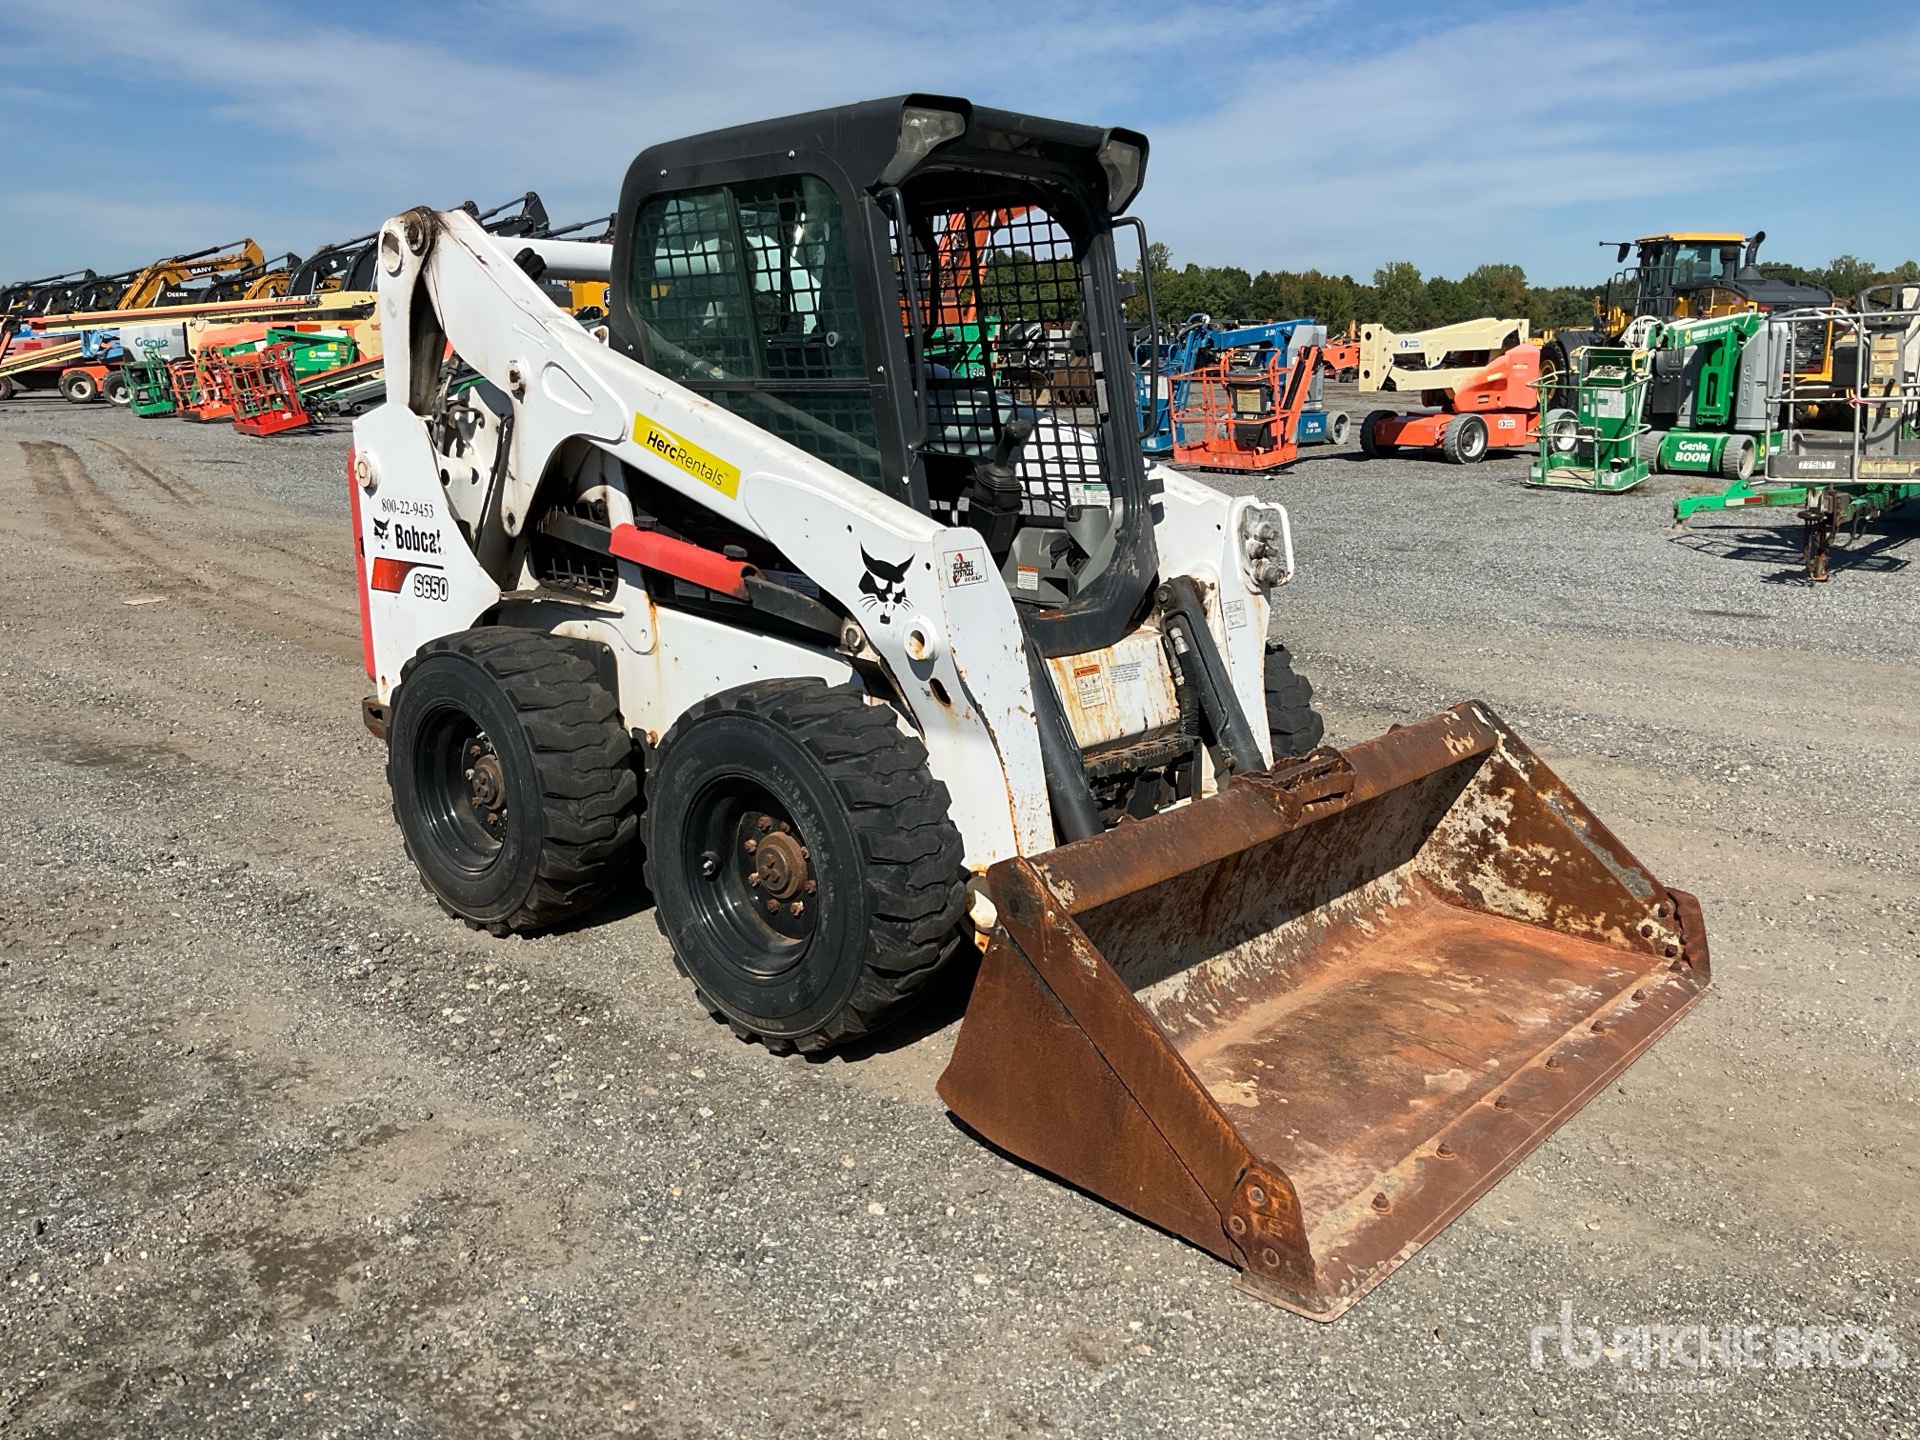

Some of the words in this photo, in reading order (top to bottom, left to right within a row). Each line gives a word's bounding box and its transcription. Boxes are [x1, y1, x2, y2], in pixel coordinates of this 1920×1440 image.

[191, 266, 212, 275] SANY
[1678, 441, 1709, 451] Genie
[1674, 452, 1711, 463] BOOM
[381, 498, 435, 519] 800-22-9453
[413, 573, 450, 602] S650
